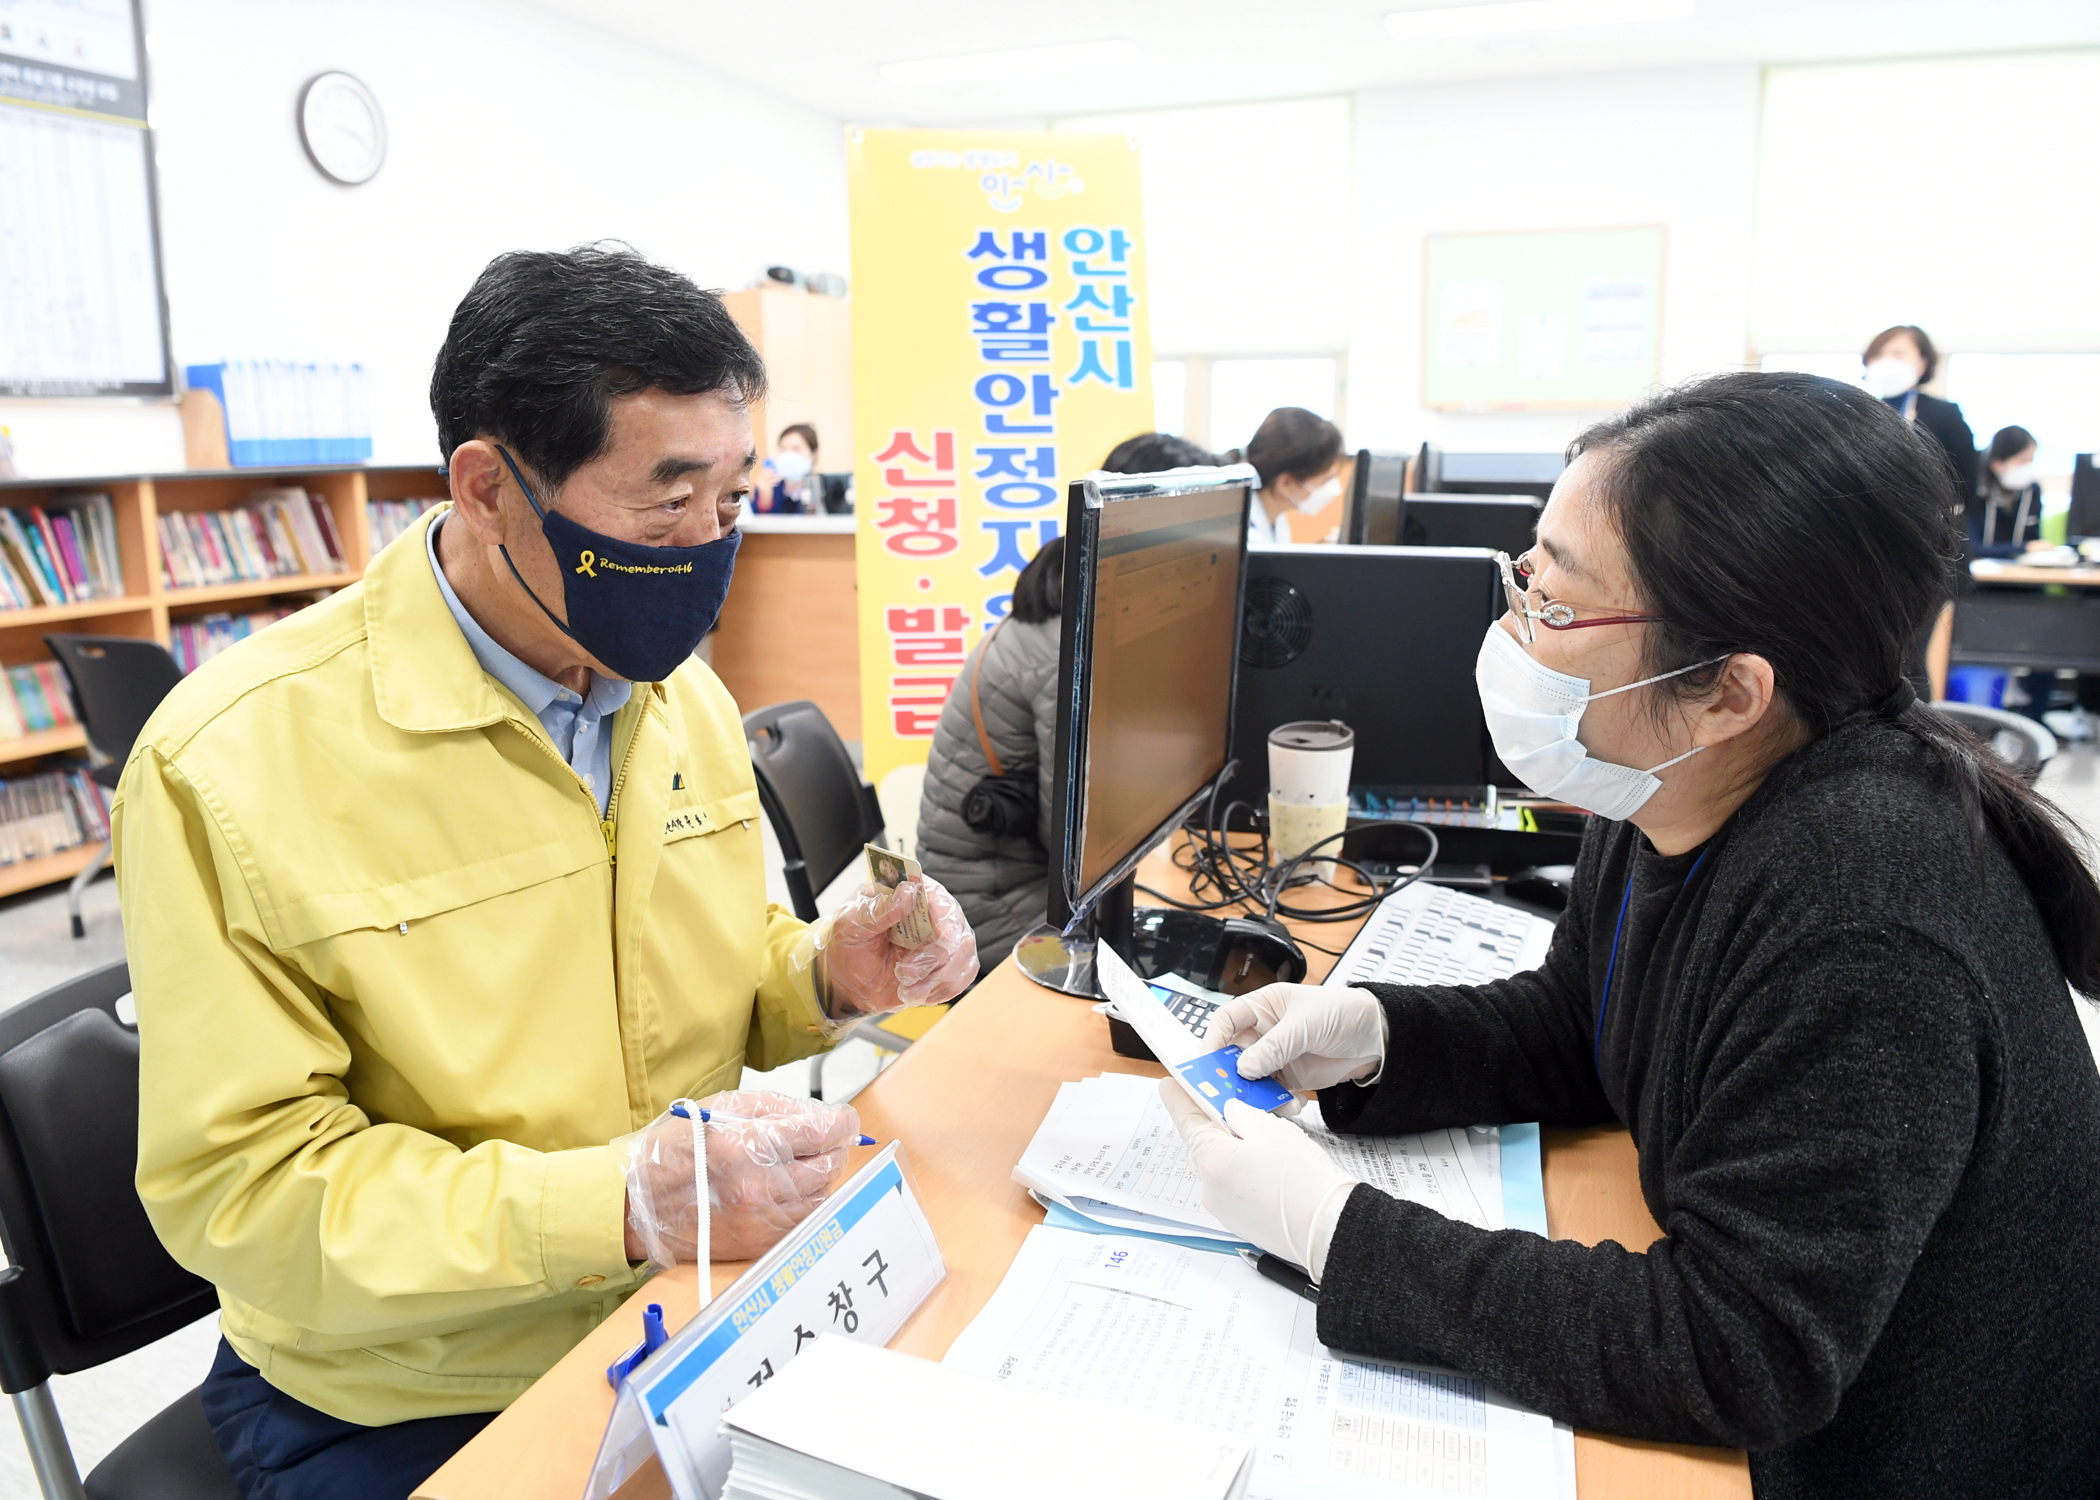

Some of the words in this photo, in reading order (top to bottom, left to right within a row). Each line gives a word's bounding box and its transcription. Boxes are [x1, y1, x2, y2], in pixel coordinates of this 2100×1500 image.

[1063, 228, 1134, 388] 안산시
[966, 231, 1060, 633] 생활안정지
[1418, 1162, 1428, 1171] 귀하
[1421, 1172, 1438, 1194] 안산시장
[1104, 1250, 1128, 1268] 146
[731, 1294, 771, 1334] 안산시
[770, 1218, 845, 1299] 생활안정지원금
[1319, 1363, 1331, 1383] 프로세스
